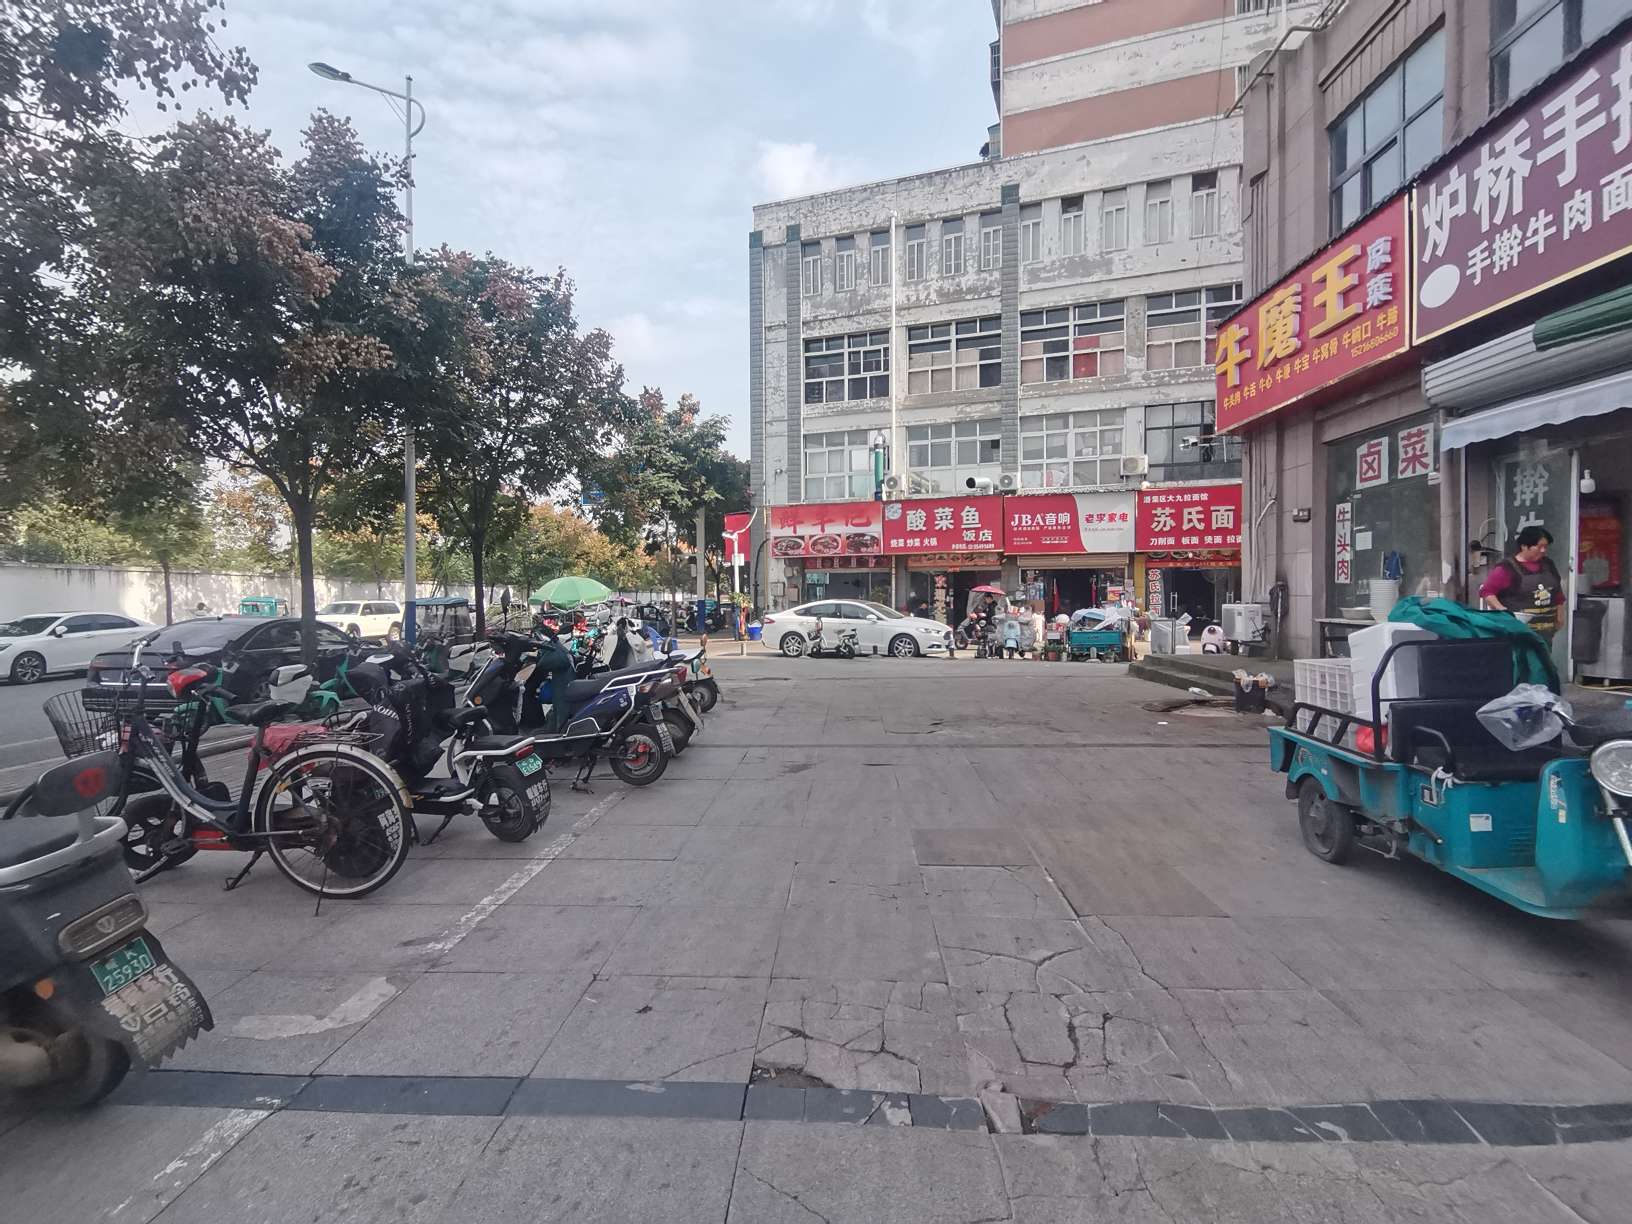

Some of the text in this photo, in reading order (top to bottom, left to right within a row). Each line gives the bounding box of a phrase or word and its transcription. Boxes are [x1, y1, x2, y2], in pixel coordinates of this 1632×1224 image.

[1216, 244, 1364, 388] 牛魔王
[1359, 428, 1430, 484] 卤菜
[906, 505, 982, 531] 酸菜鱼
[962, 529, 993, 542] 饭店
[1150, 506, 1235, 532] 苏氏面
[1336, 507, 1350, 581] 牛头肉
[103, 953, 151, 990] 25930
